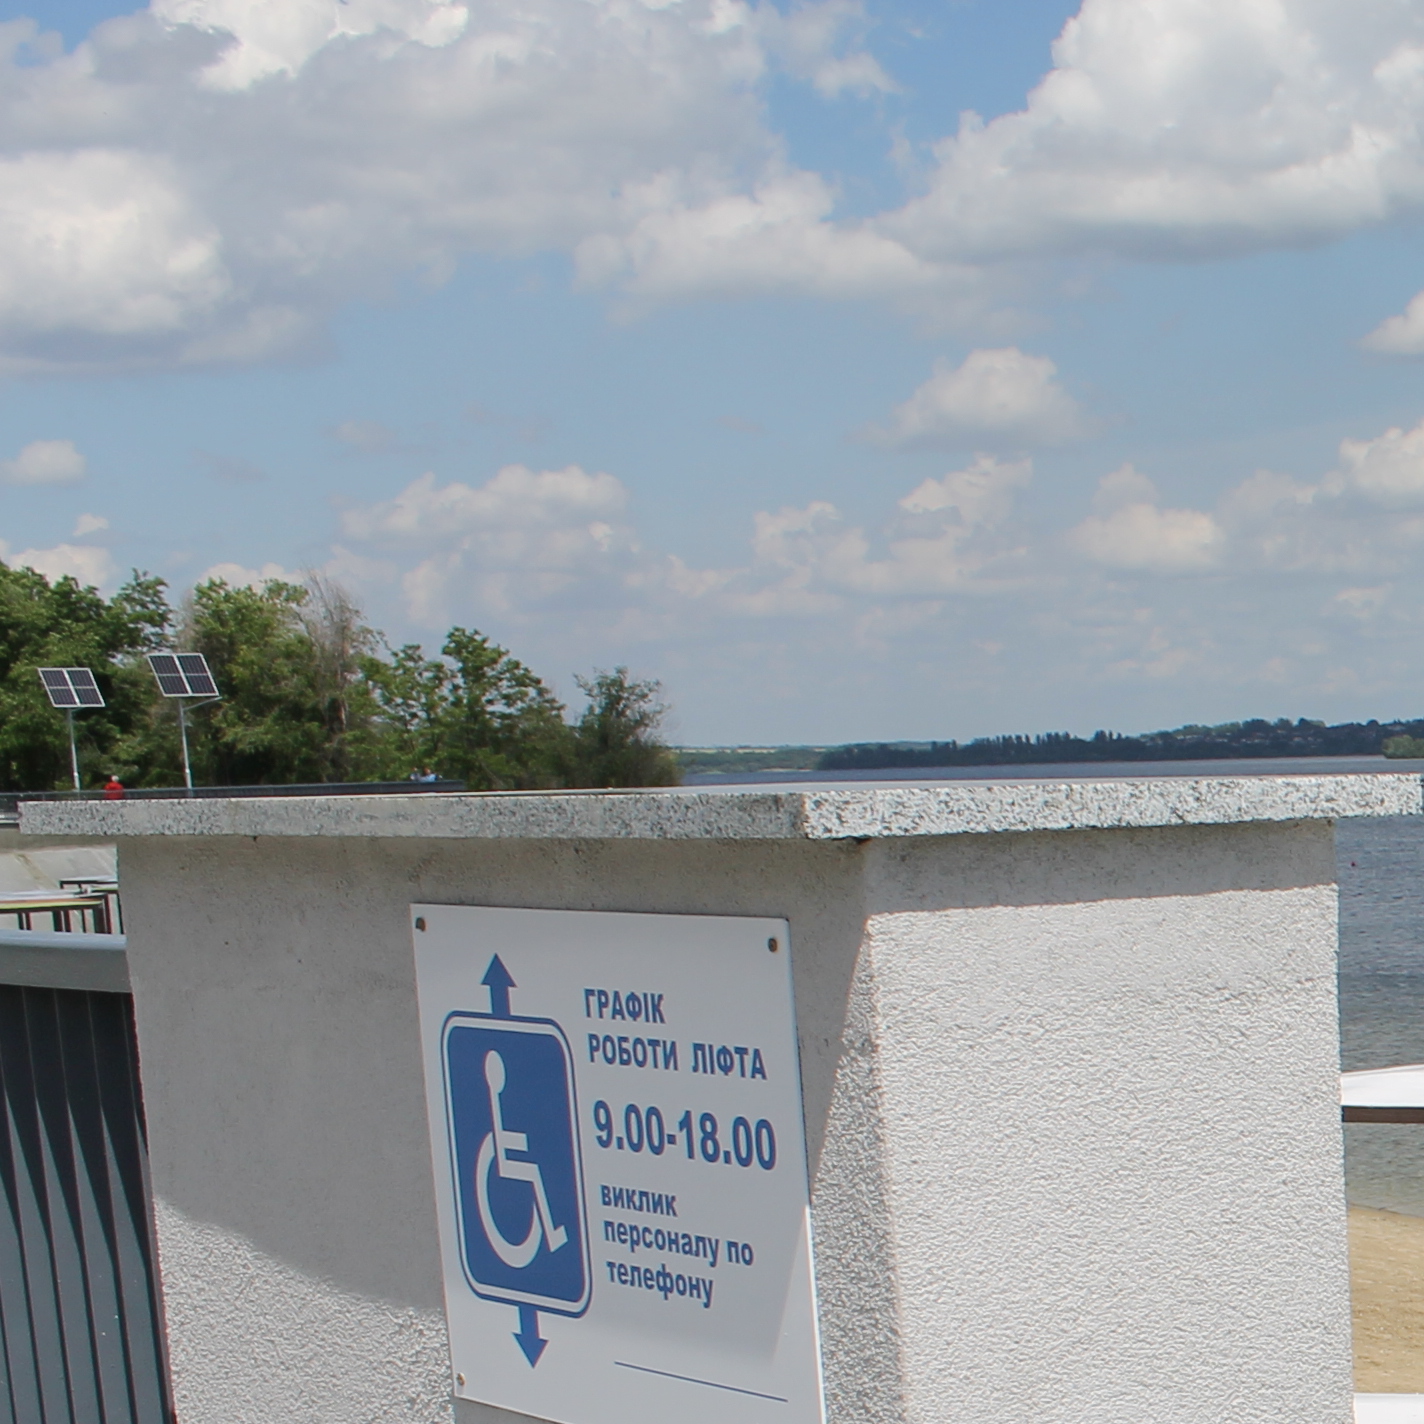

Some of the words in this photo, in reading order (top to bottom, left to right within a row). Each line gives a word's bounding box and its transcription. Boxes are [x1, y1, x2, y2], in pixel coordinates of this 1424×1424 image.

[583, 987, 665, 1024] ГРАФІК
[587, 1033, 678, 1071] РОБОТИ
[690, 1042, 766, 1080] ЛІФТА
[592, 1099, 776, 1171] 9.00-18.00
[600, 1184, 677, 1217] виклик
[603, 1220, 719, 1267] персоналу
[726, 1240, 754, 1266] по
[606, 1260, 713, 1308] телефону
